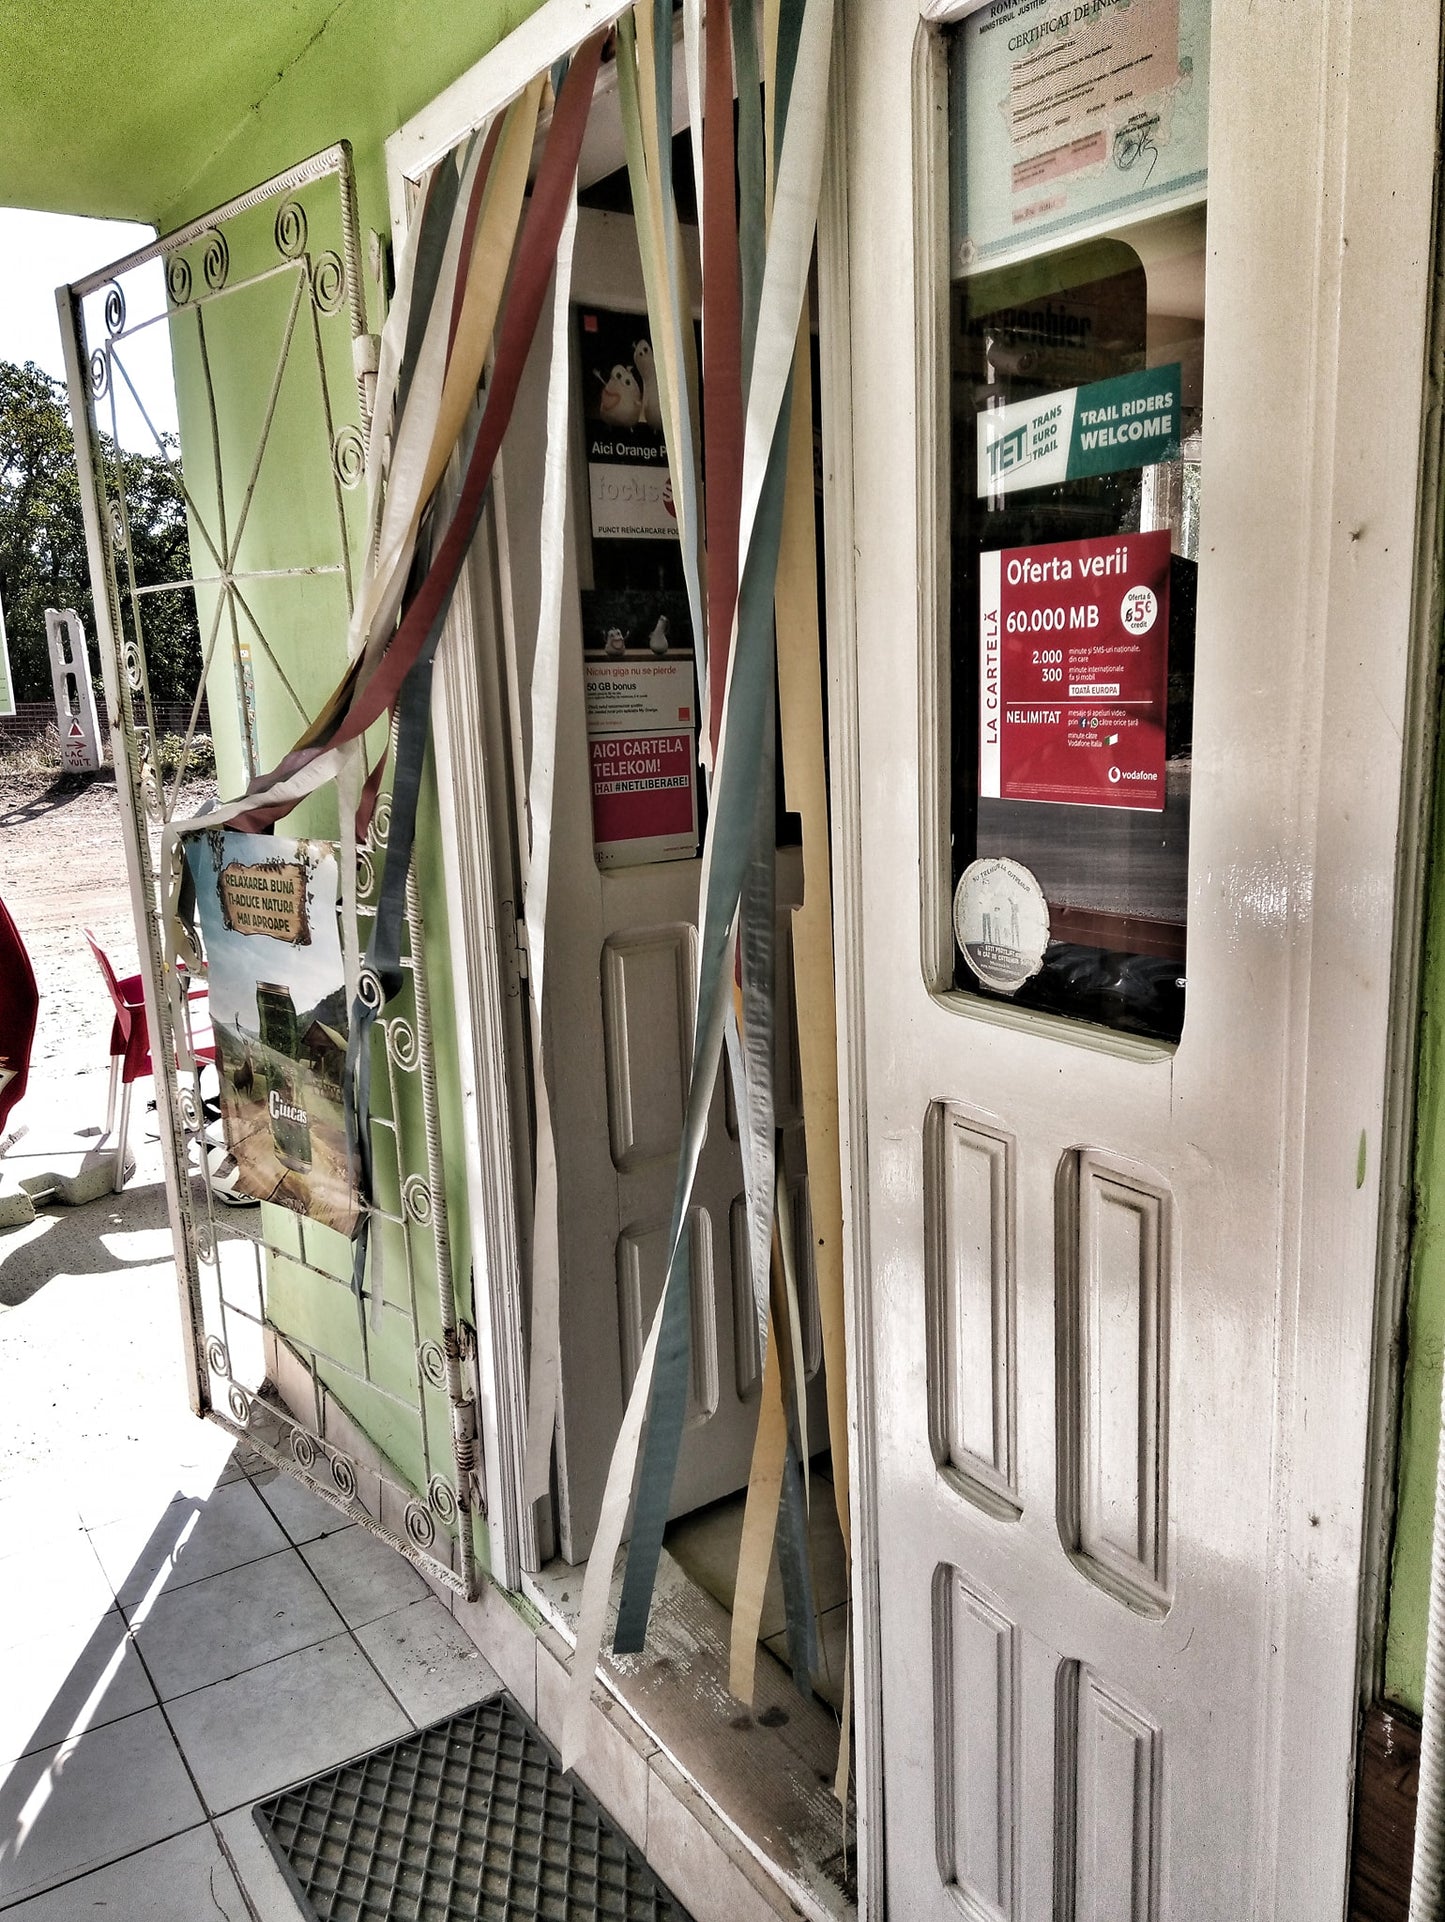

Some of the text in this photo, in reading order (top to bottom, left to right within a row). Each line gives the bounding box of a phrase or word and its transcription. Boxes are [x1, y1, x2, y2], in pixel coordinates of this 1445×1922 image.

[1008, 12, 1071, 51] CERTIFICAT
[1074, 3, 1089, 21] DE
[1032, 405, 1062, 429] TRANS
[1081, 392, 1173, 426] TRAIL RIDERS
[1033, 424, 1057, 445] EURO
[1081, 415, 1172, 451] WELCOME
[592, 441, 668, 459] Aici Orange P
[986, 424, 1027, 477] TET
[1033, 440, 1058, 460] TRAIL
[598, 526, 619, 534] PUNCT
[1007, 546, 1128, 585] Oferta verii
[1128, 593, 1146, 602] Oferta
[1006, 605, 1099, 633] 60.000 MB
[1130, 621, 1147, 629] credit
[1032, 650, 1063, 664] 2.000
[1093, 645, 1113, 654] SMS-uri
[1069, 655, 1077, 663] din
[587, 665, 677, 678] Niciun giga nu se pierde
[984, 609, 998, 744] LA CARTELĂ
[1041, 668, 1063, 682] 300
[1069, 665, 1087, 673] minute
[1081, 673, 1095, 681] mobil
[587, 681, 637, 692] 50 GB bonus
[1072, 685, 1118, 695] TOATĂ EUROPA
[1006, 710, 1061, 724] NELIMITAT
[1092, 709, 1110, 717] apeluri
[593, 738, 683, 759] AICI CARTELA
[1068, 739, 1103, 748] Vodafone Italia
[65, 749, 83, 758] LAC
[594, 758, 661, 778] TELEKOM!
[1122, 768, 1158, 782] vodafone
[595, 776, 688, 794] HAI #NETLIBERARE!
[225, 873, 294, 895] RELAXAREA BUNĂ
[262, 896, 294, 914] NATURA
[237, 912, 291, 933] MAI APROAPE
